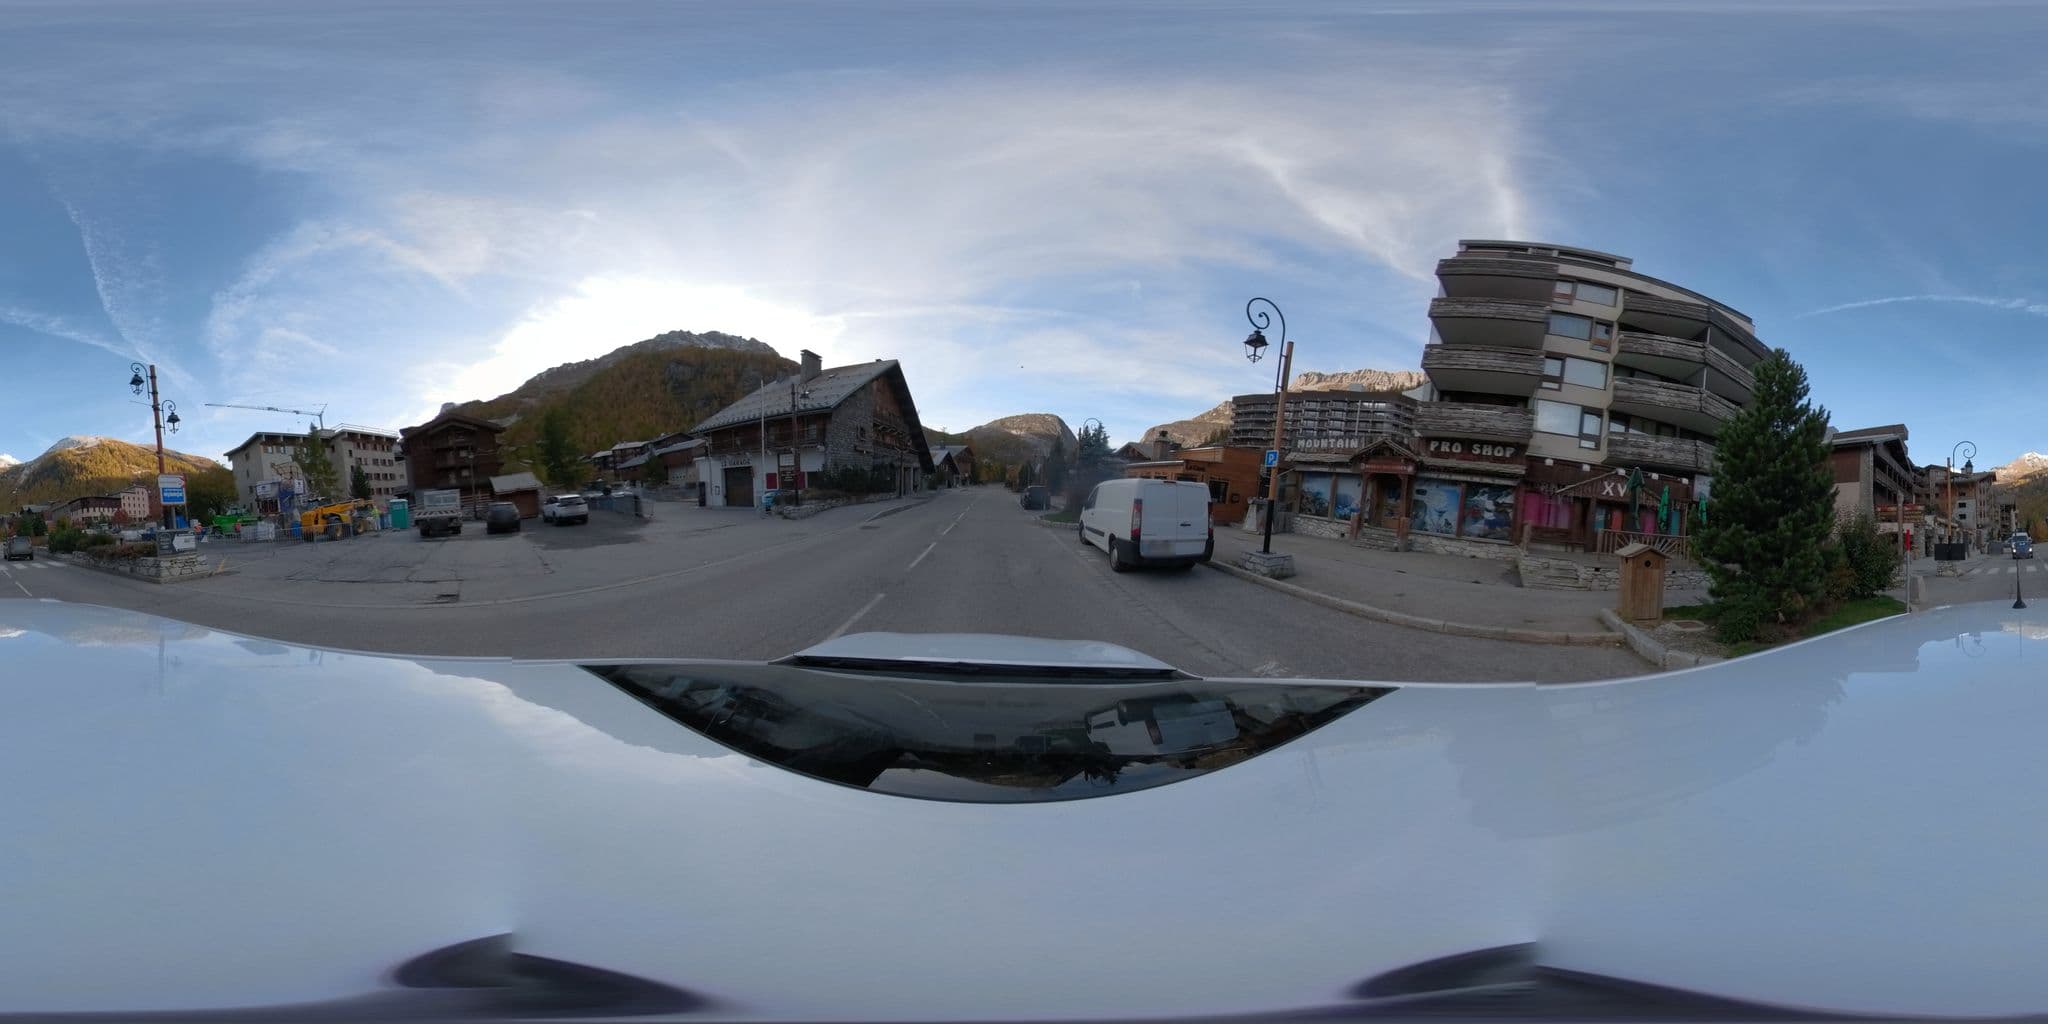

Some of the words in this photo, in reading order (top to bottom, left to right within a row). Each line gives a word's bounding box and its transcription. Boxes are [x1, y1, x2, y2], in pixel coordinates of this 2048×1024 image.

[1297, 438, 1358, 448] MOUNTAIN
[1430, 440, 1462, 453] PRO
[1471, 443, 1515, 458] SHOP
[1601, 481, 1627, 497] XV
